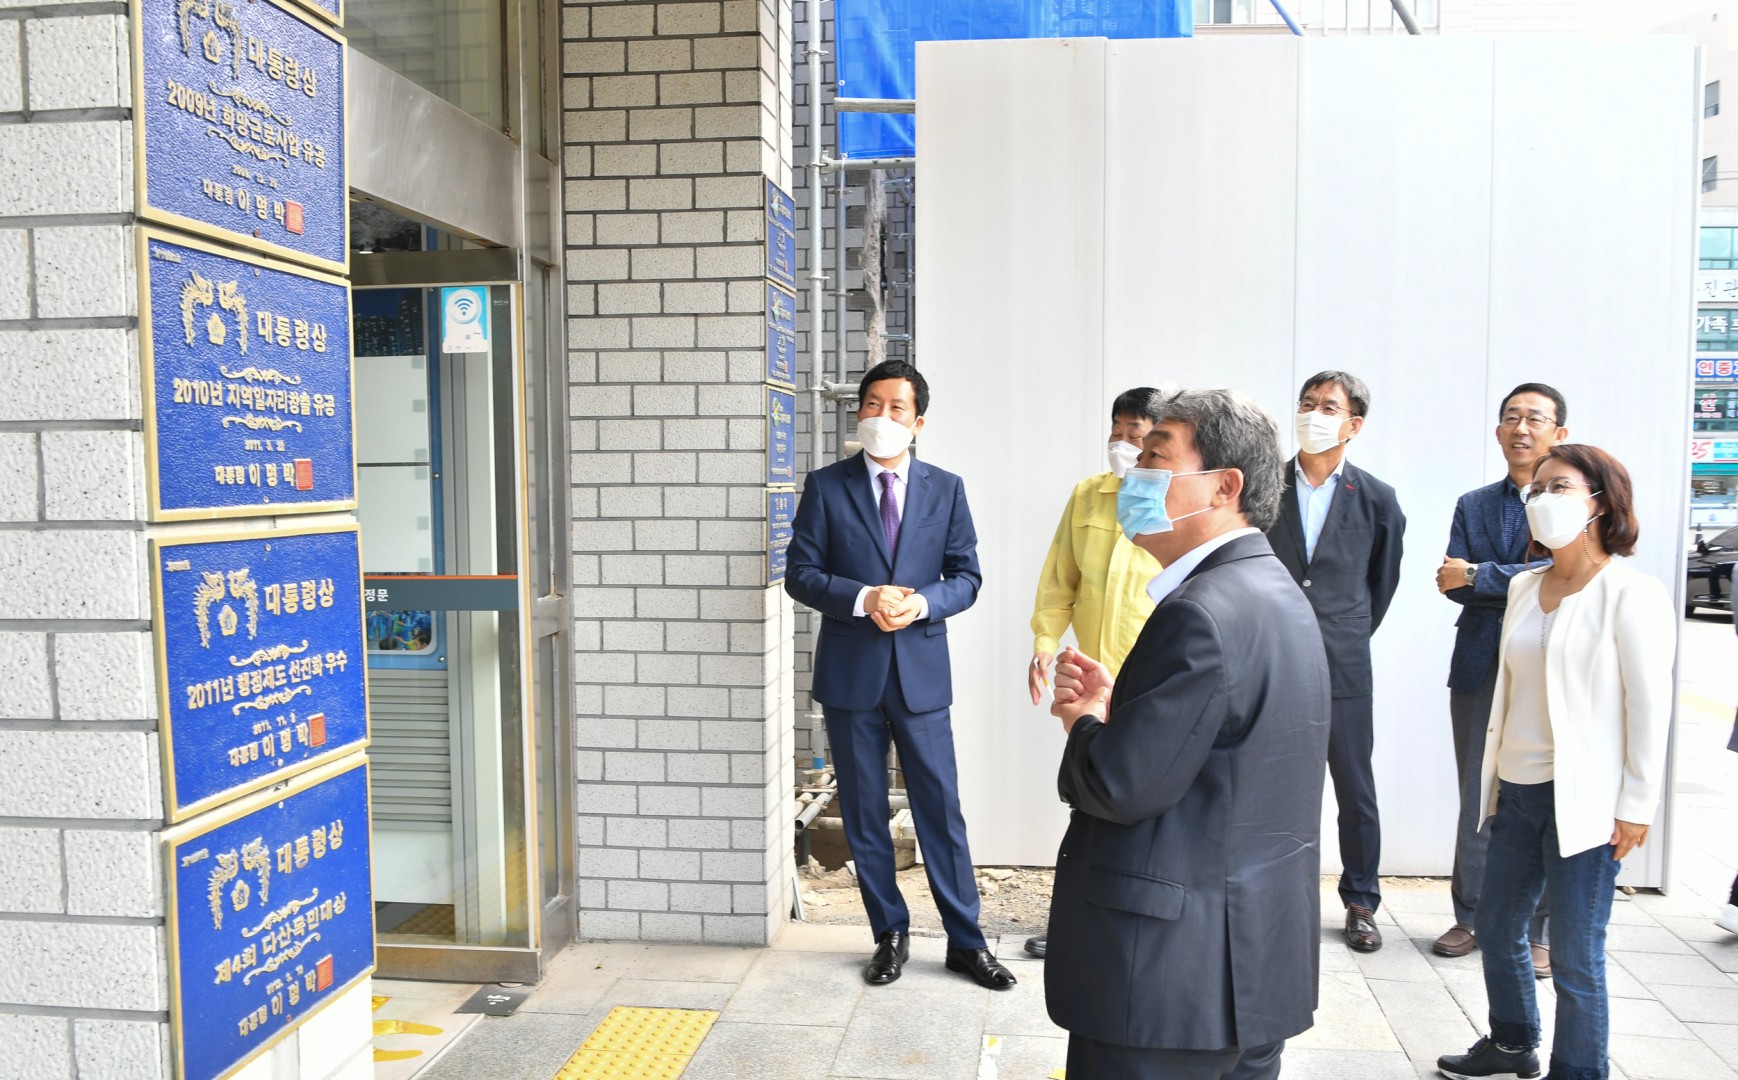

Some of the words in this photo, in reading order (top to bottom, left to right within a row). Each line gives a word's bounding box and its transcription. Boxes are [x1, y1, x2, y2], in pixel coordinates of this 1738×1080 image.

[248, 36, 317, 97] 대통령상
[167, 80, 216, 122] 2009년
[222, 105, 299, 158] 희망근로사업
[303, 139, 325, 169] 유공
[203, 179, 233, 206] 대통령
[257, 311, 327, 352] 대통령상
[1697, 316, 1728, 333] 가족
[173, 378, 223, 406] 2010년
[227, 383, 311, 415] 지역일자리창출
[313, 394, 335, 416] 유공
[214, 465, 245, 485] 대통령
[265, 578, 335, 615] 대통령상
[364, 588, 389, 602] 정문
[187, 675, 234, 710] 2011년
[237, 664, 287, 697] 행정제도
[289, 654, 323, 684] 선진화
[325, 650, 348, 675] 우수
[228, 742, 258, 767] 대통령
[276, 819, 344, 874] 대통령상
[214, 943, 256, 985] 제4회
[261, 891, 346, 955] 다산목민대상
[237, 1004, 267, 1036] 대통령
